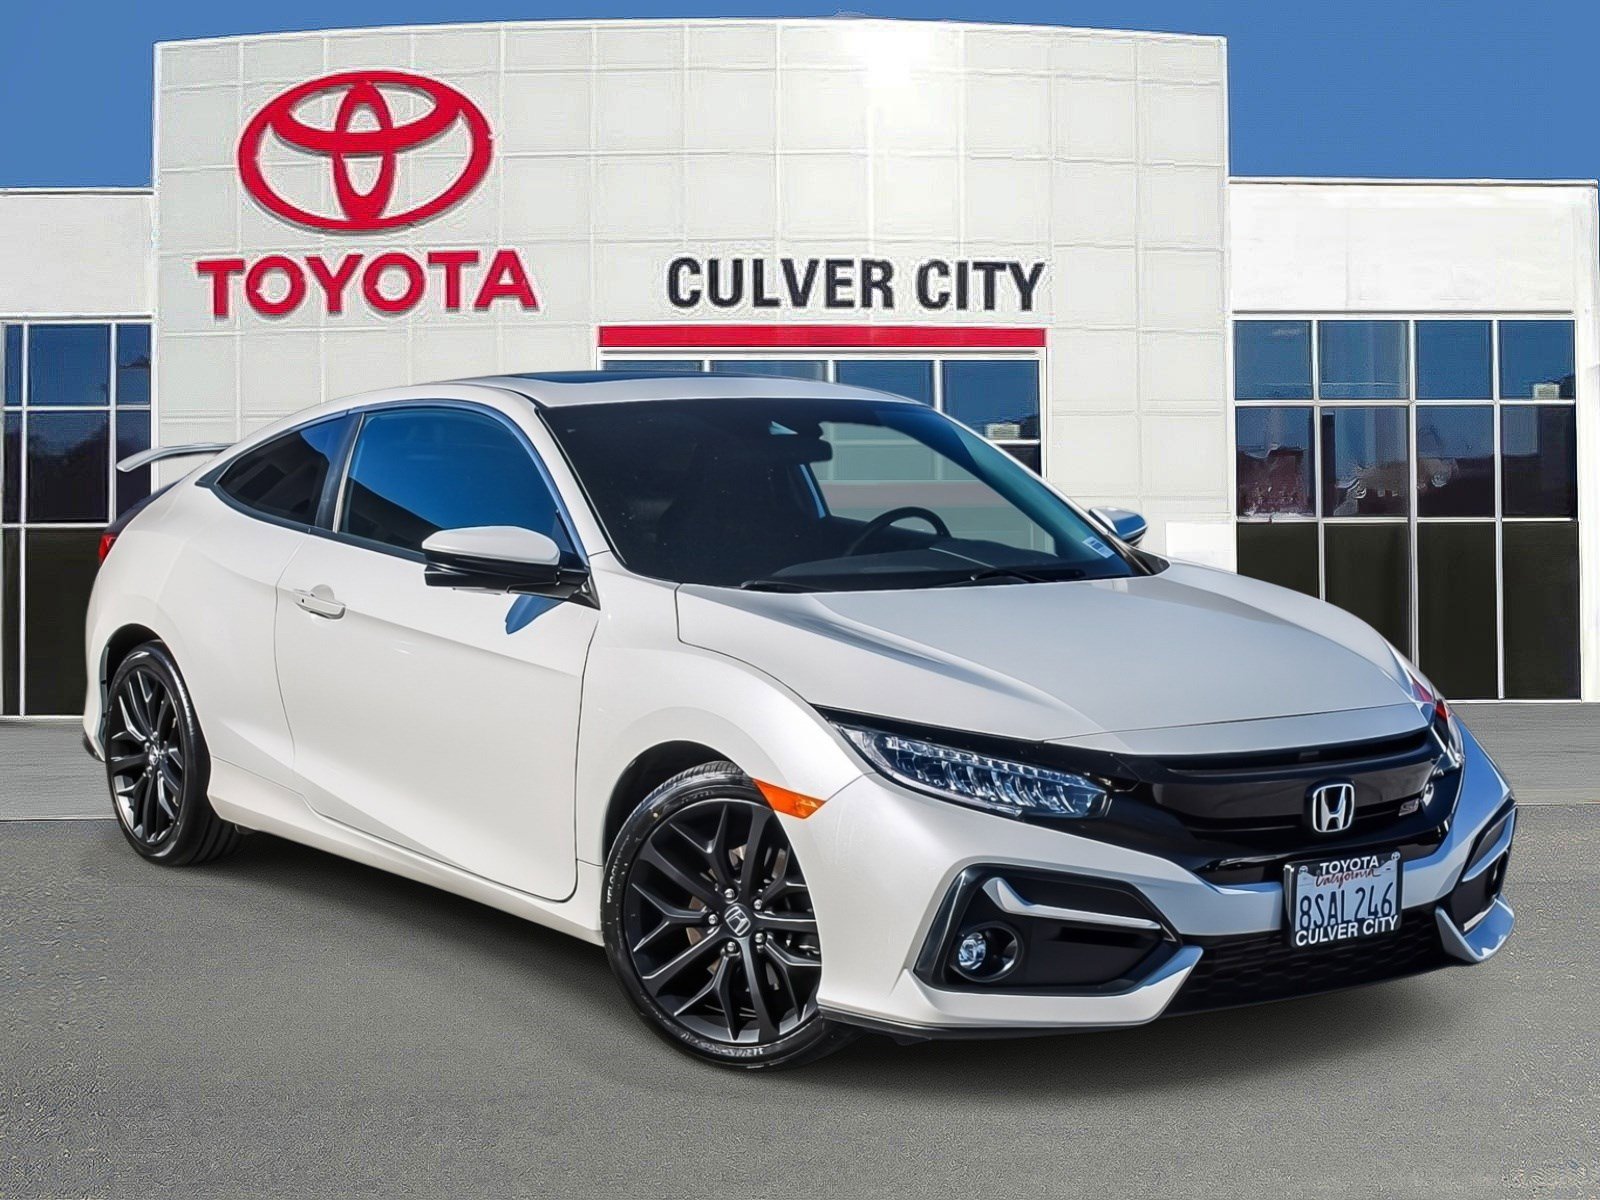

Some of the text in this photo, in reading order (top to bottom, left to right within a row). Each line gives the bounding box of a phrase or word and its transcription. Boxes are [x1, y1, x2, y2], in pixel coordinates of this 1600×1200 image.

[196, 249, 539, 319] TOYOTA
[667, 256, 1045, 311] CULVER CITY
[1320, 855, 1379, 875] TOYOTA
[1299, 881, 1393, 929] 8SAL246
[1295, 914, 1398, 946] CULVER CITY
